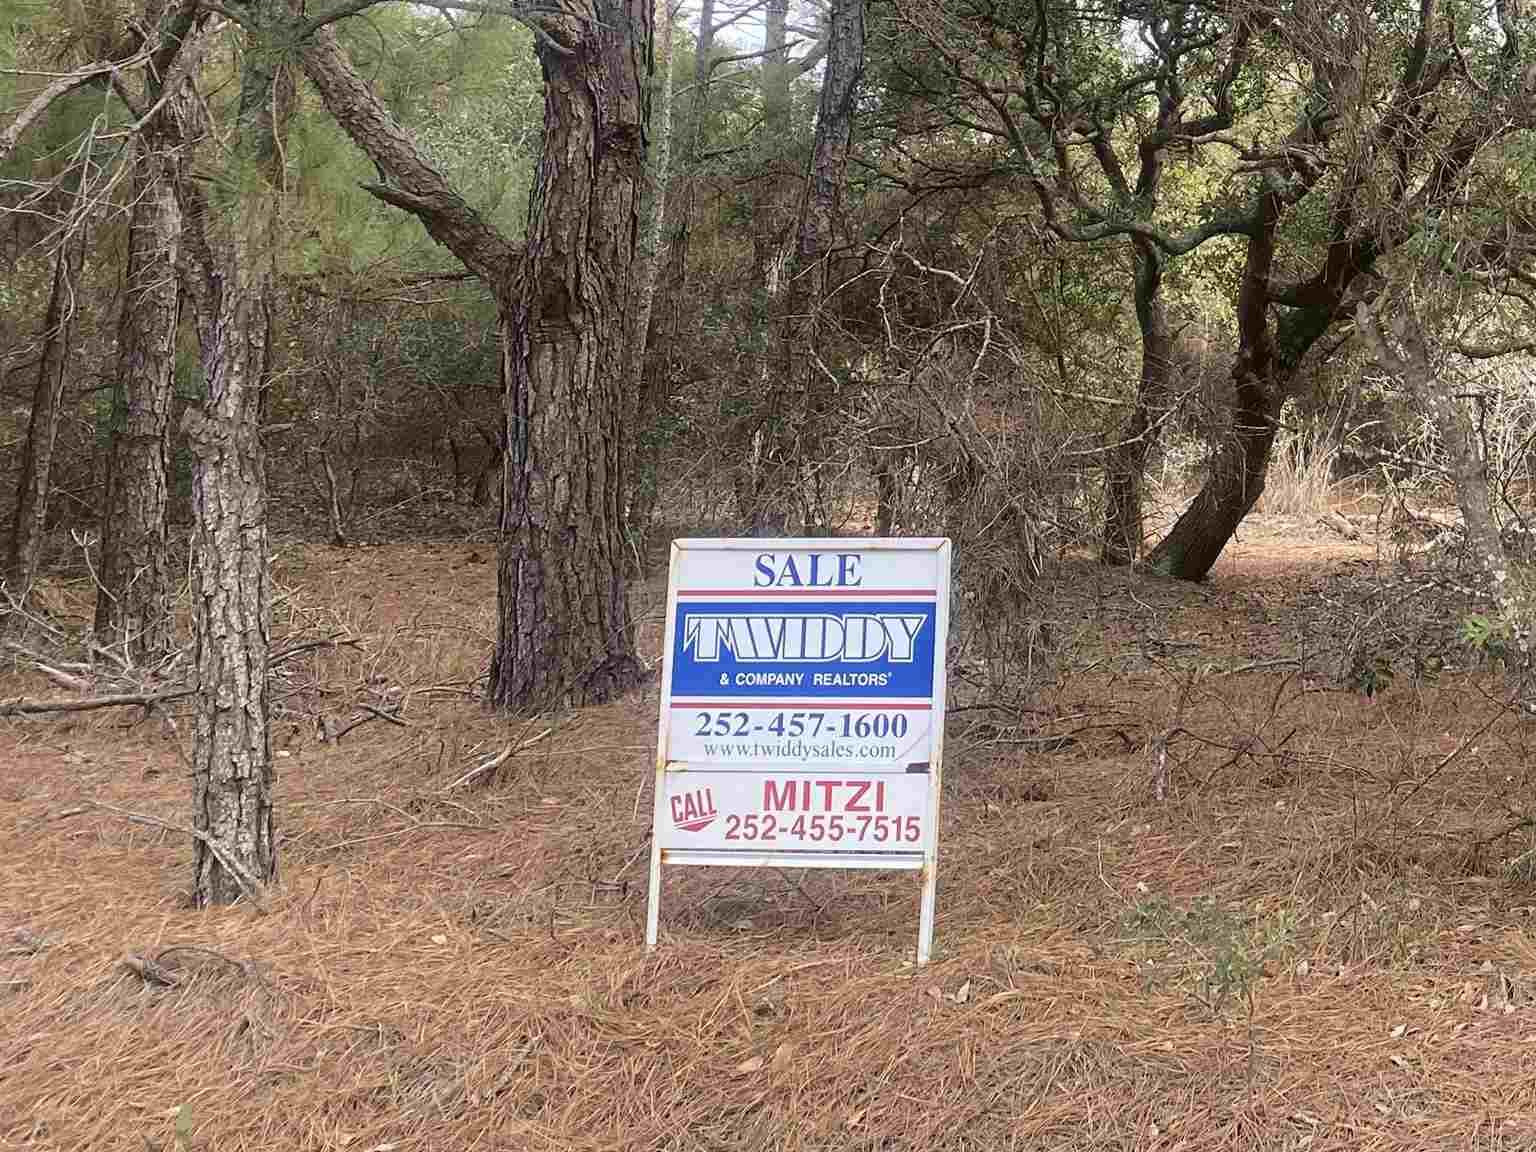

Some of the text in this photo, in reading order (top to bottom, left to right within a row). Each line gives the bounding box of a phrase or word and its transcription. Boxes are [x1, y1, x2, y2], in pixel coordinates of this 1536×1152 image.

[753, 553, 862, 587] SALE
[683, 613, 928, 663] TWIDDY
[719, 673, 729, 686] &
[735, 673, 804, 686] COMPANY
[695, 712, 908, 739] 252-457-1600
[703, 739, 896, 760] www.twiddysales.com
[671, 788, 717, 823] CALL
[763, 780, 885, 812] MITZI
[725, 814, 920, 842] 252-455-7515
